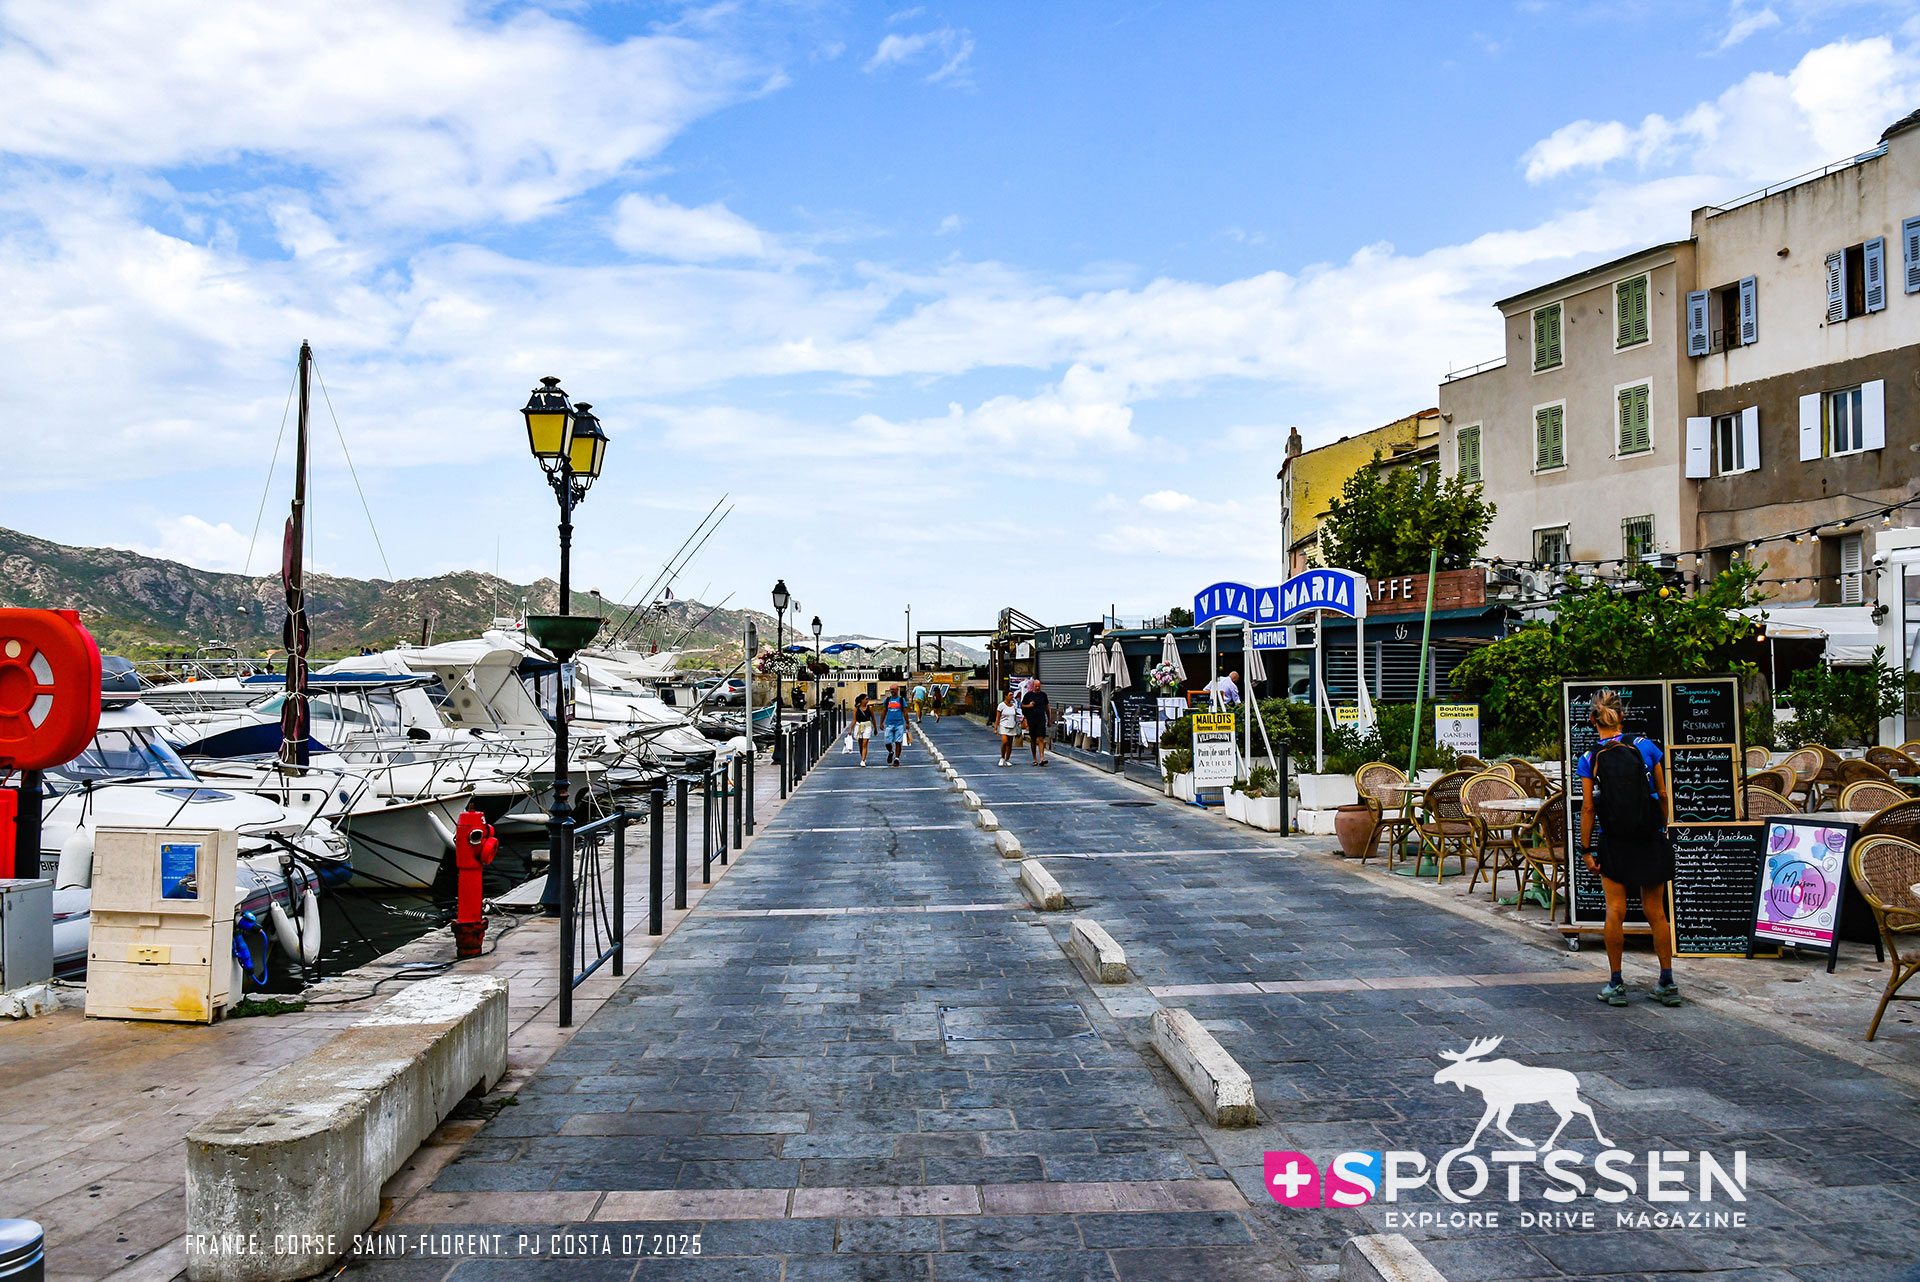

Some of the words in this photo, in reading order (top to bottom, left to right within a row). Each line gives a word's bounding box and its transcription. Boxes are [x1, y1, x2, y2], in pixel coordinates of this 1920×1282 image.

[1199, 588, 1248, 615] VIVA
[1284, 576, 1349, 613] MARIA
[1050, 624, 1071, 648] Vogue
[1253, 631, 1286, 646] BOUTIQUE
[1196, 714, 1231, 724] MAILLOTS
[1682, 720, 1726, 730] RESTAURANT
[1686, 735, 1724, 743] PIZZERIA
[1693, 830, 1715, 841] carte
[1782, 870, 1816, 888] Maison
[1788, 927, 1817, 936] Artisanales
